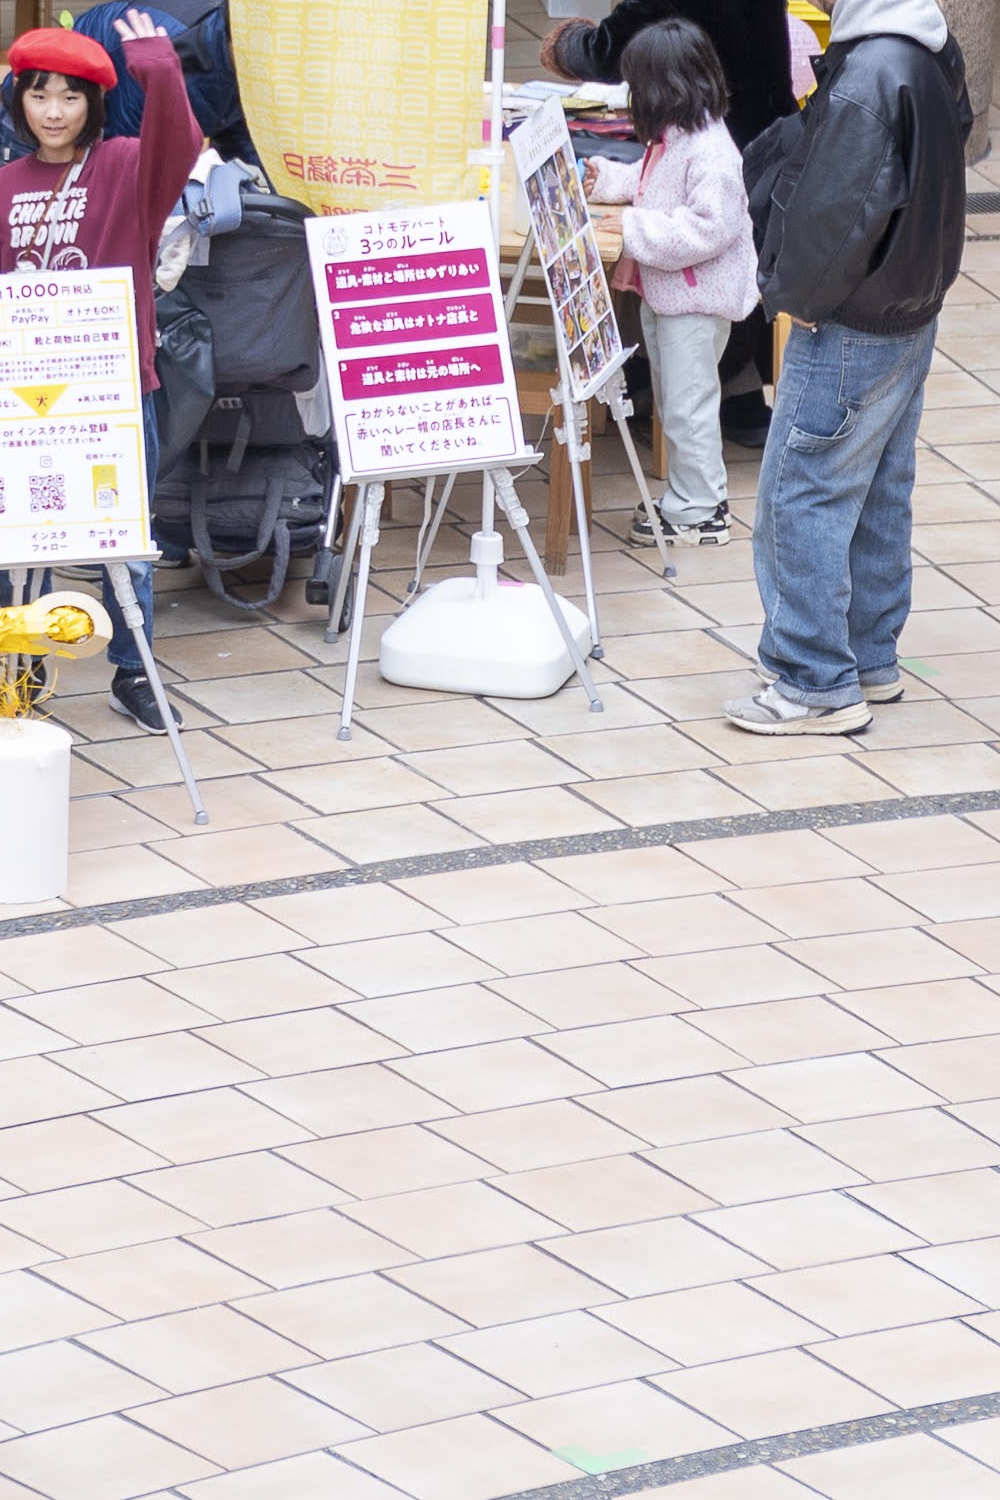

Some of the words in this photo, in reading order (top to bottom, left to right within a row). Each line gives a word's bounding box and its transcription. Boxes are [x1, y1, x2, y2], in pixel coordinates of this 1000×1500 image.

[8, 197, 87, 226] CHARLIE
[360, 231, 454, 254] 3つのルール
[11, 314, 50, 324] PayPay
[334, 311, 340, 319] 2
[350, 309, 478, 335] 危険な道具はオトナ店長と
[34, 332, 120, 345] 靴と荷物は自己管理
[340, 363, 347, 371] 3
[362, 362, 481, 386] 道具と素材は元の場所へ
[361, 394, 492, 419] わからないことがあれば
[18, 423, 108, 437] インスタグラム登録
[357, 415, 501, 440] 赤いベレー帽の店長さんに
[31, 531, 67, 540] インスタ
[32, 543, 69, 552] フォロー
